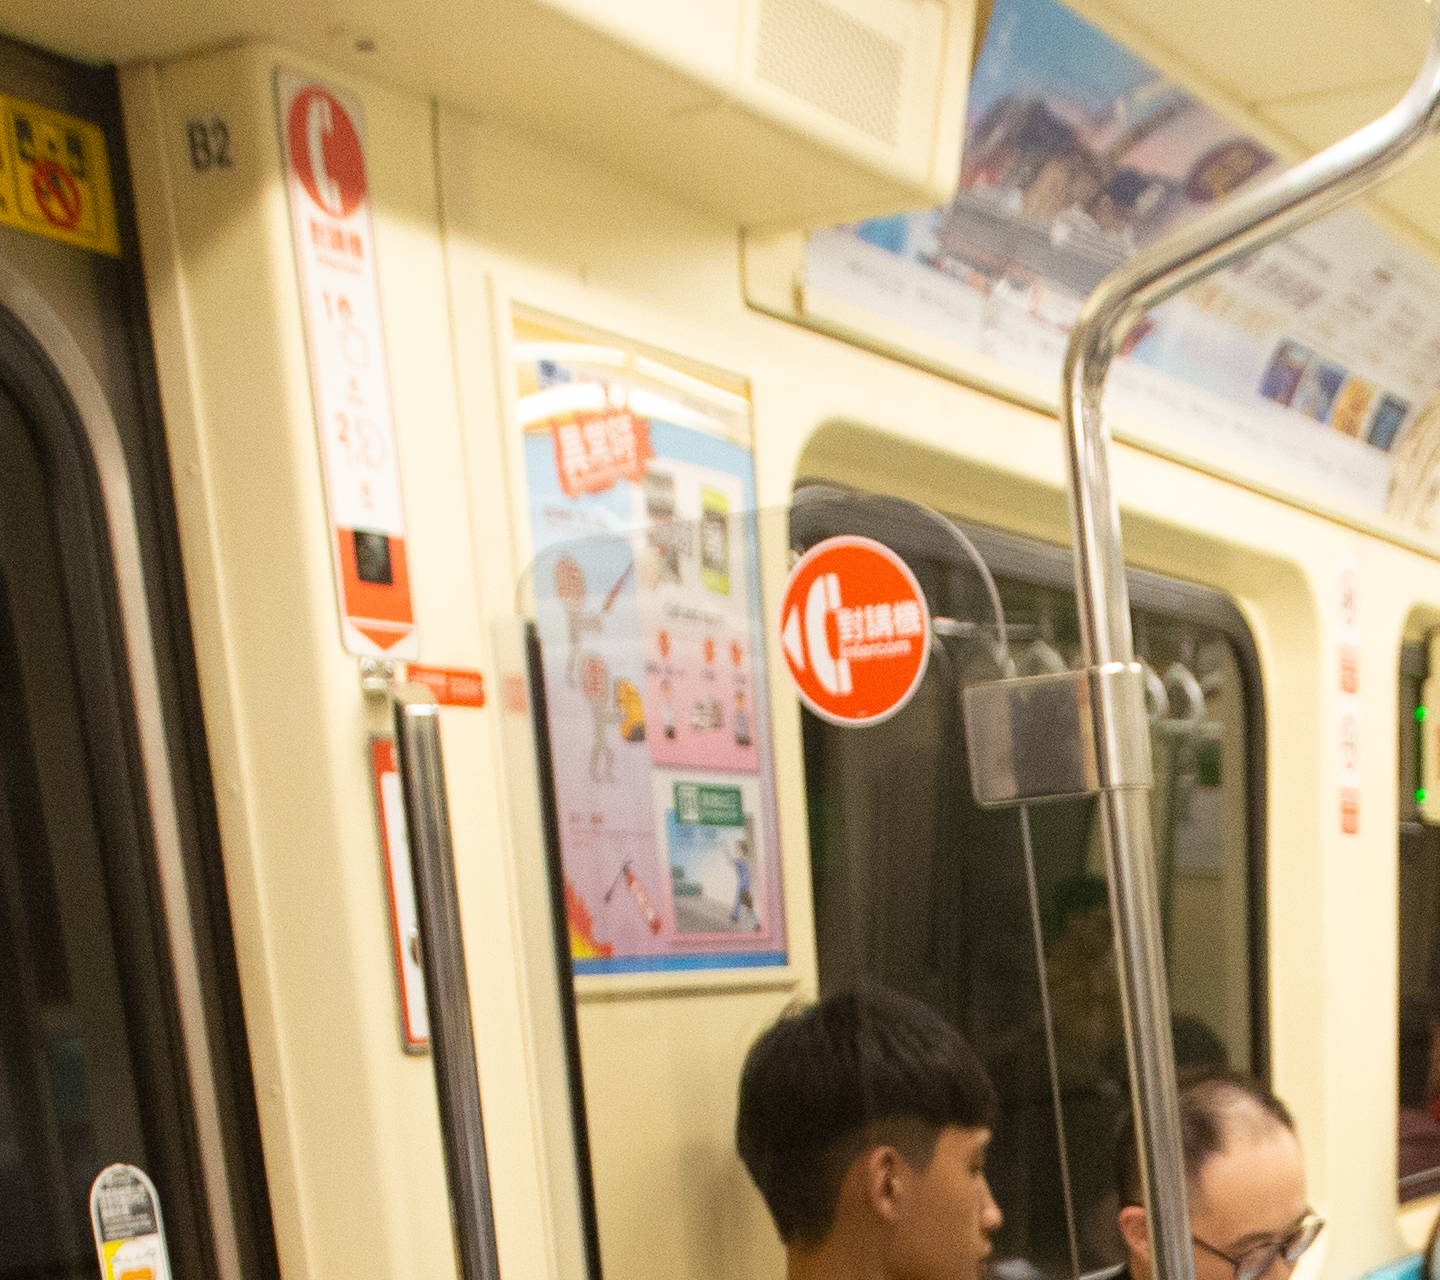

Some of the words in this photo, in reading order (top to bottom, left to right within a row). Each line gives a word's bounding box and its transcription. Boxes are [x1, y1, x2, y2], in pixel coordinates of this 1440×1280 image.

[186, 117, 233, 171] B2
[834, 600, 921, 642] 對講機
